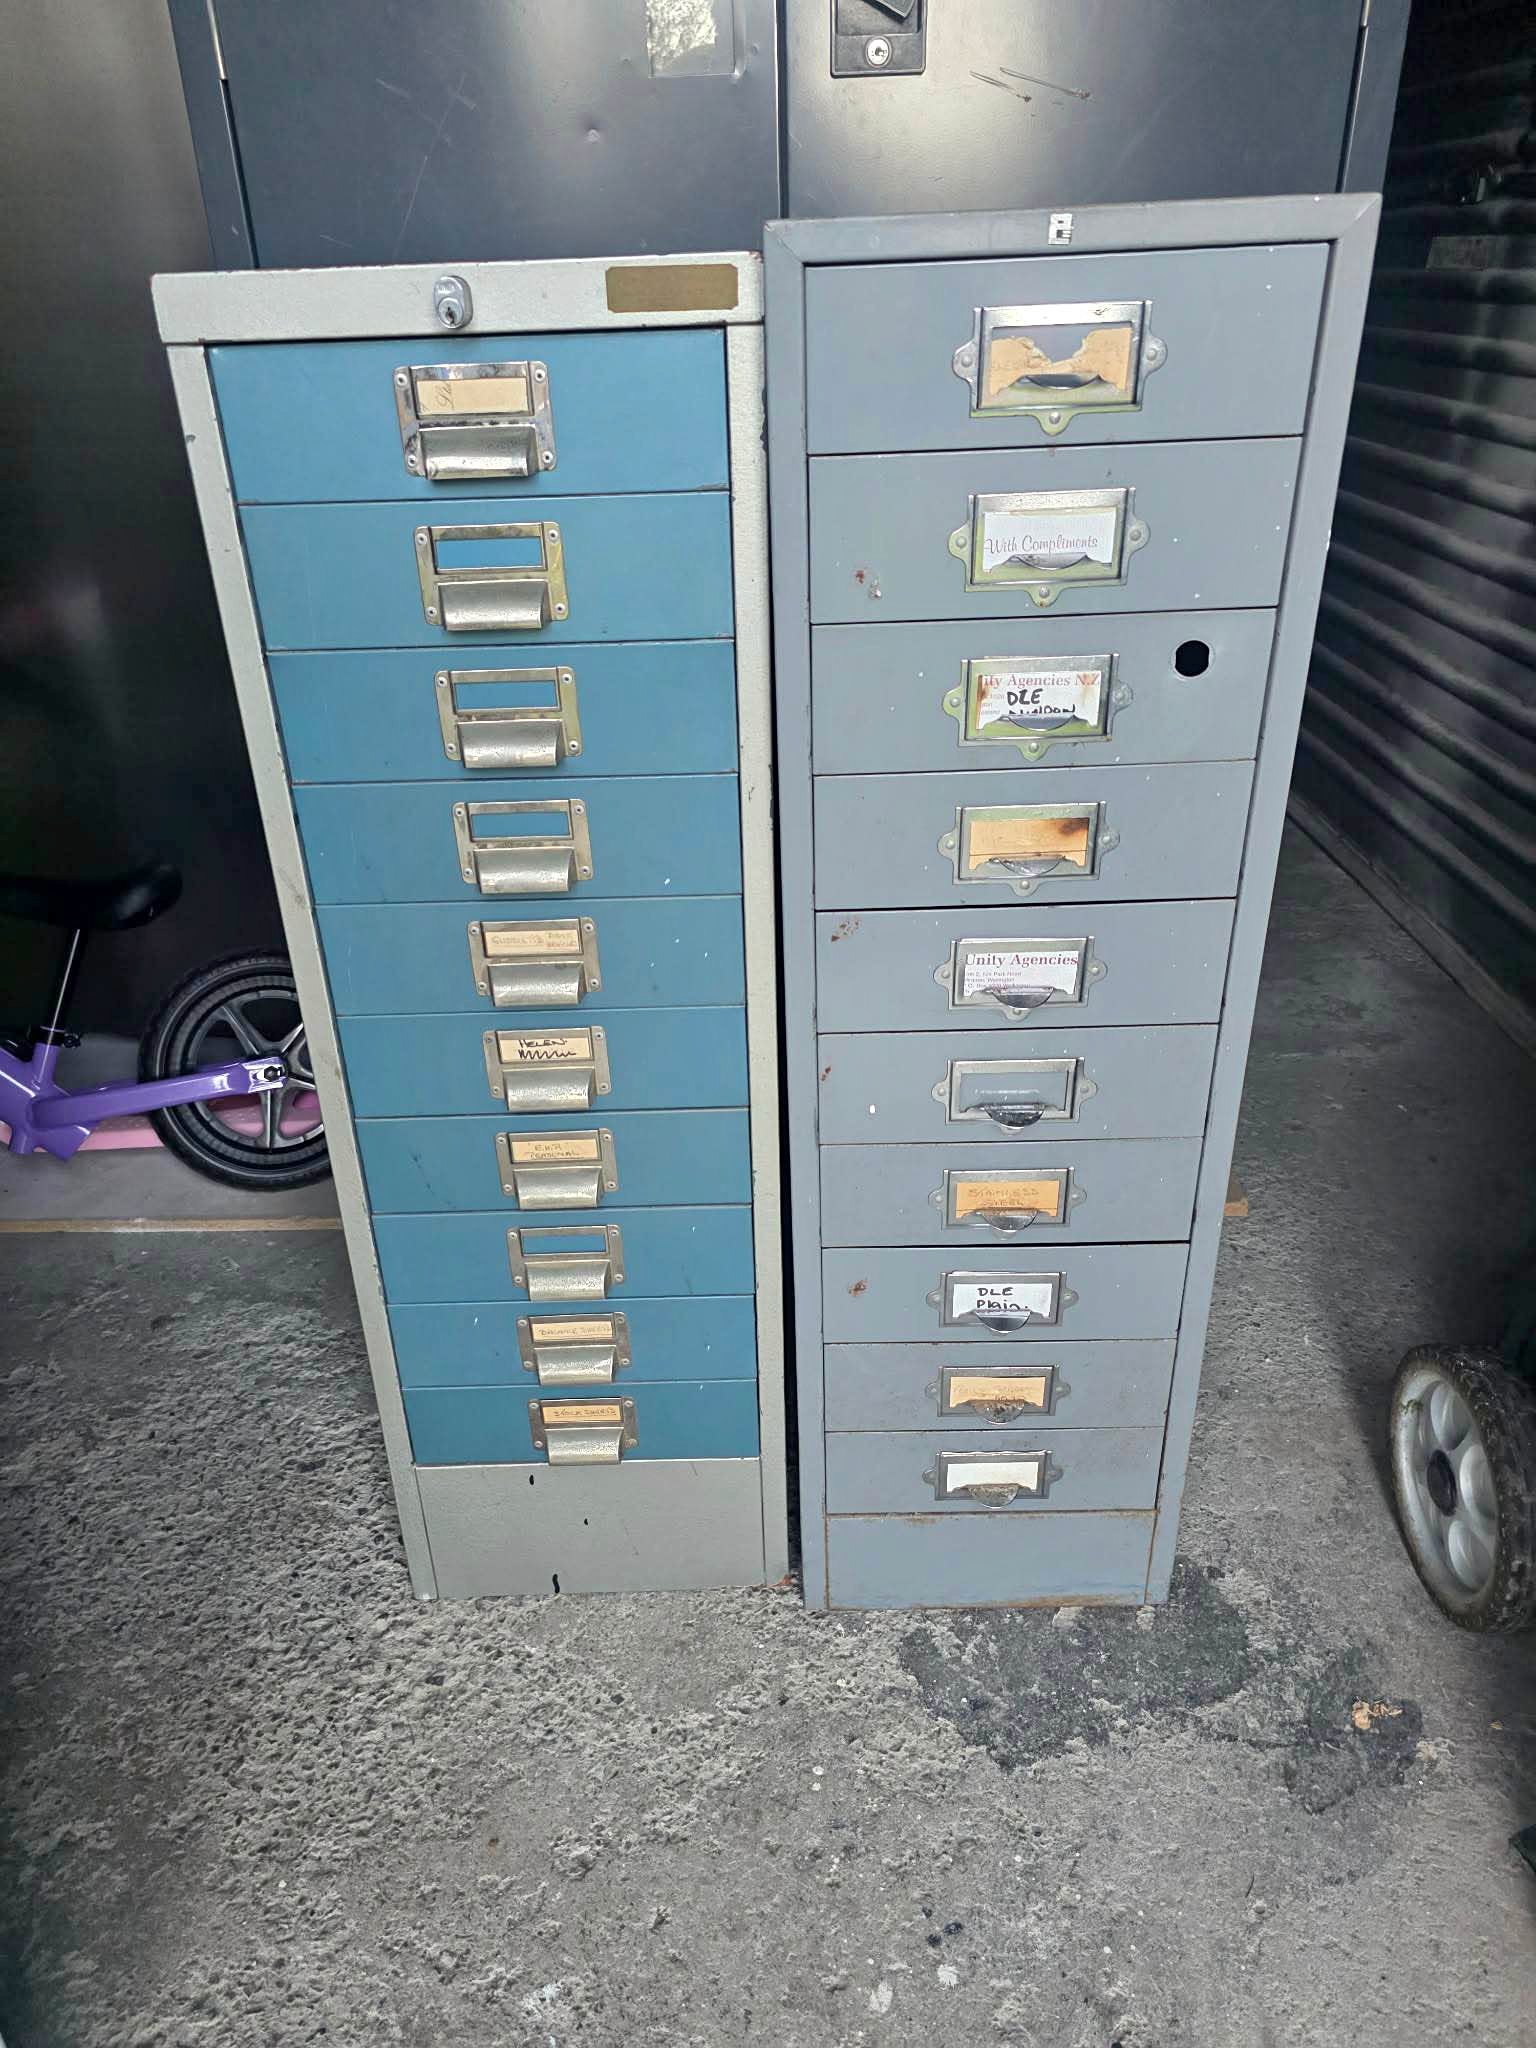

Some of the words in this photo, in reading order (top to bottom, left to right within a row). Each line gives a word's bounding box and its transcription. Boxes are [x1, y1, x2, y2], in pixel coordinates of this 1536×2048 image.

[985, 537, 1018, 554] With
[1022, 534, 1098, 552] Compliments
[1008, 673, 1071, 689] Agencies
[965, 953, 1006, 969] Unity
[1011, 953, 1079, 969] Agencies
[977, 1287, 1014, 1297] DLE
